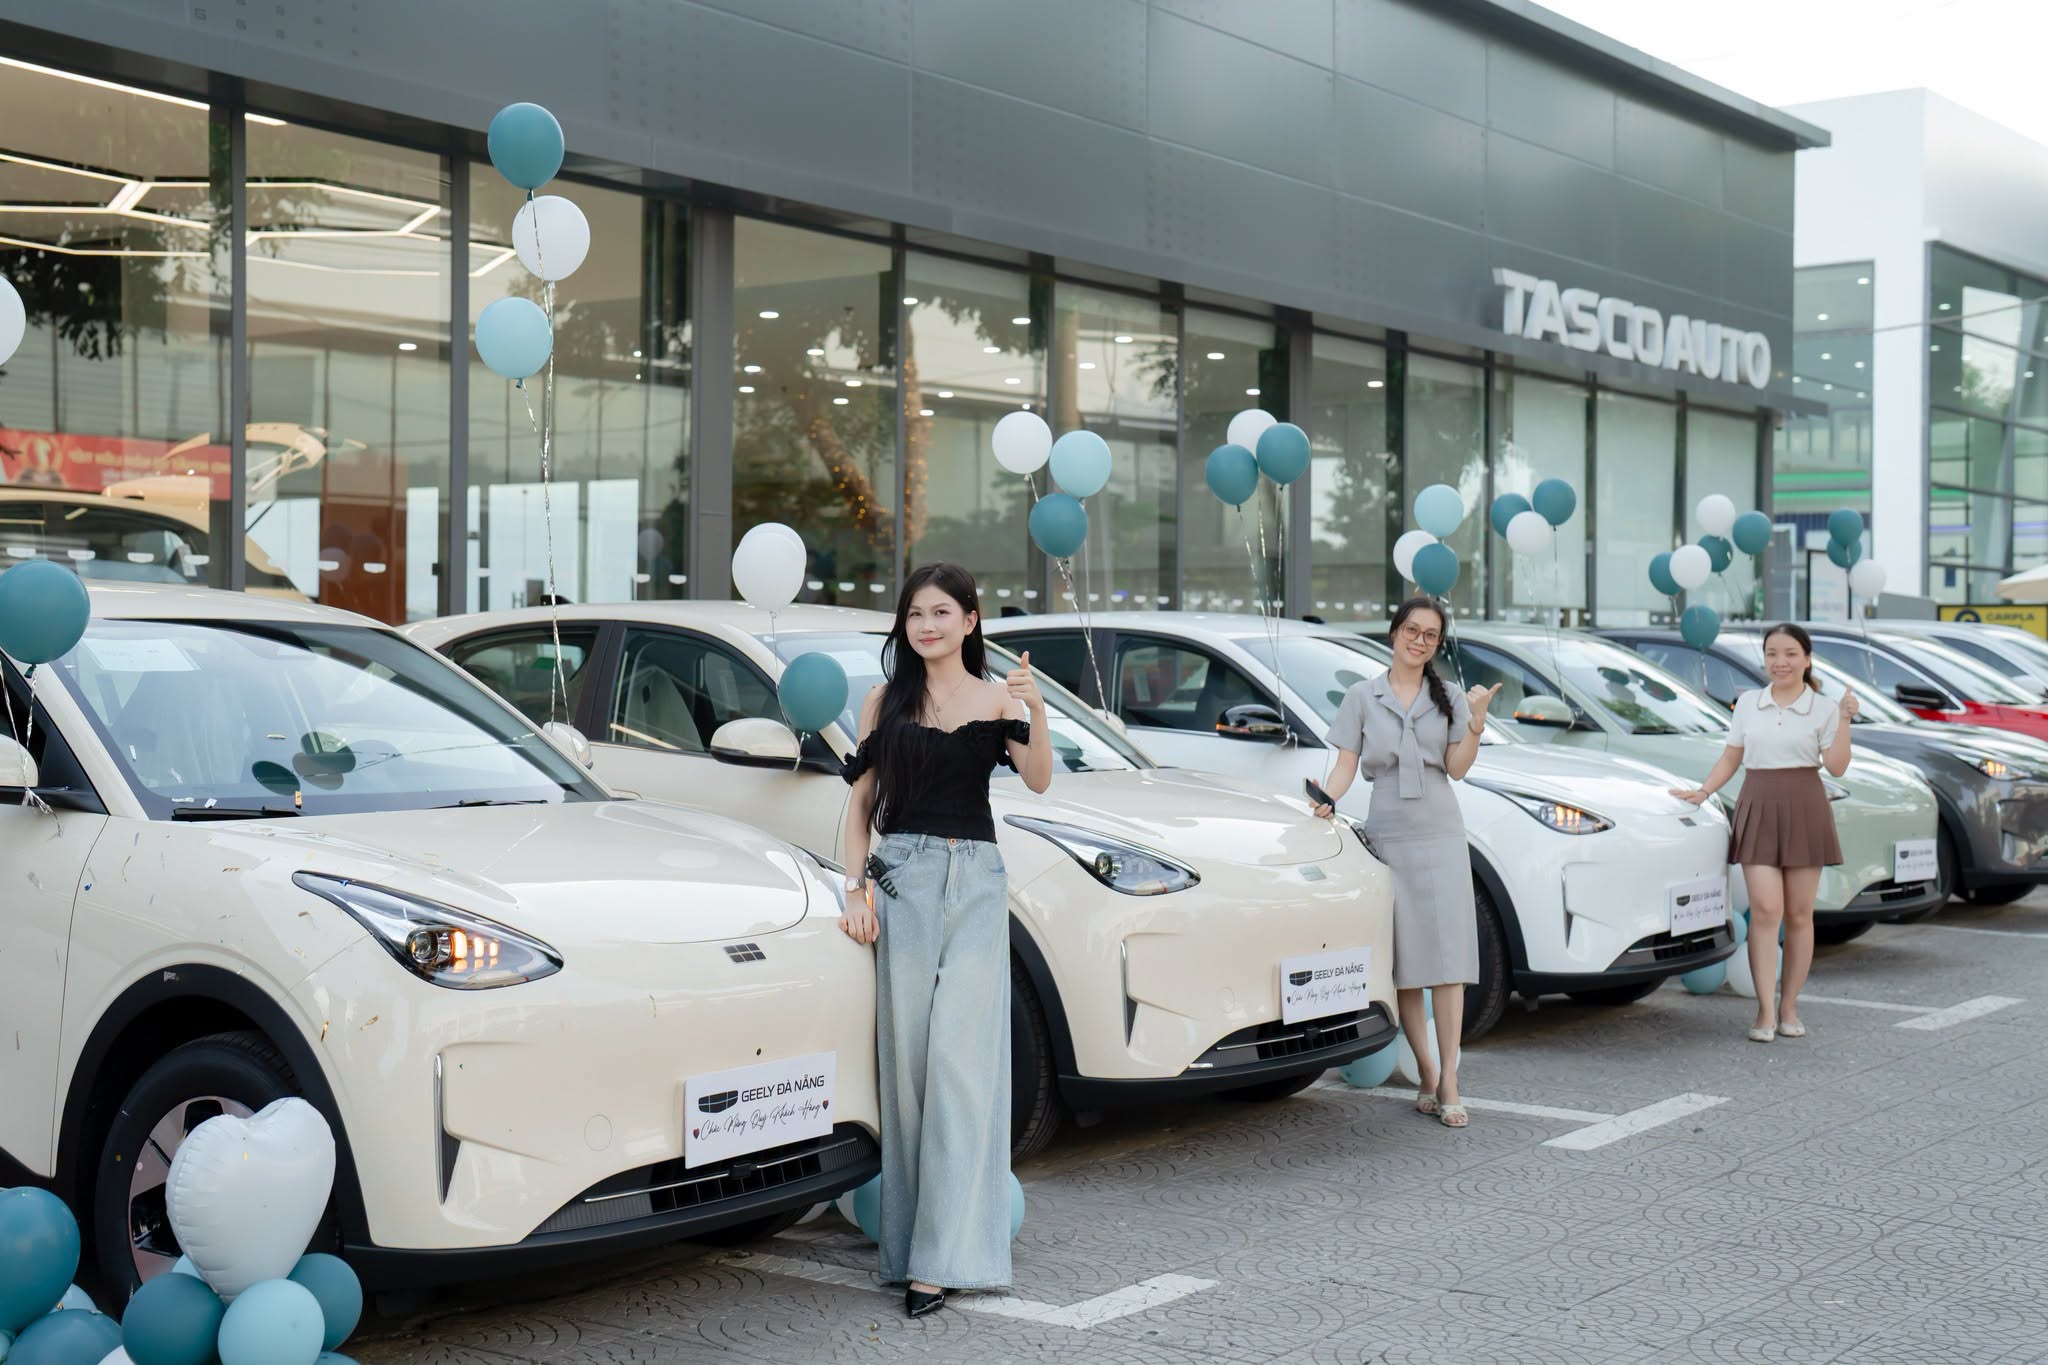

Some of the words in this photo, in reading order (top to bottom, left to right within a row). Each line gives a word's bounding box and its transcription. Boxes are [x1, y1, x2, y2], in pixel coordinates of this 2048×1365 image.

[1314, 967, 1334, 980] GEELY
[741, 1084, 776, 1103] GEELY
[776, 1079, 792, 1096] ĐÀ
